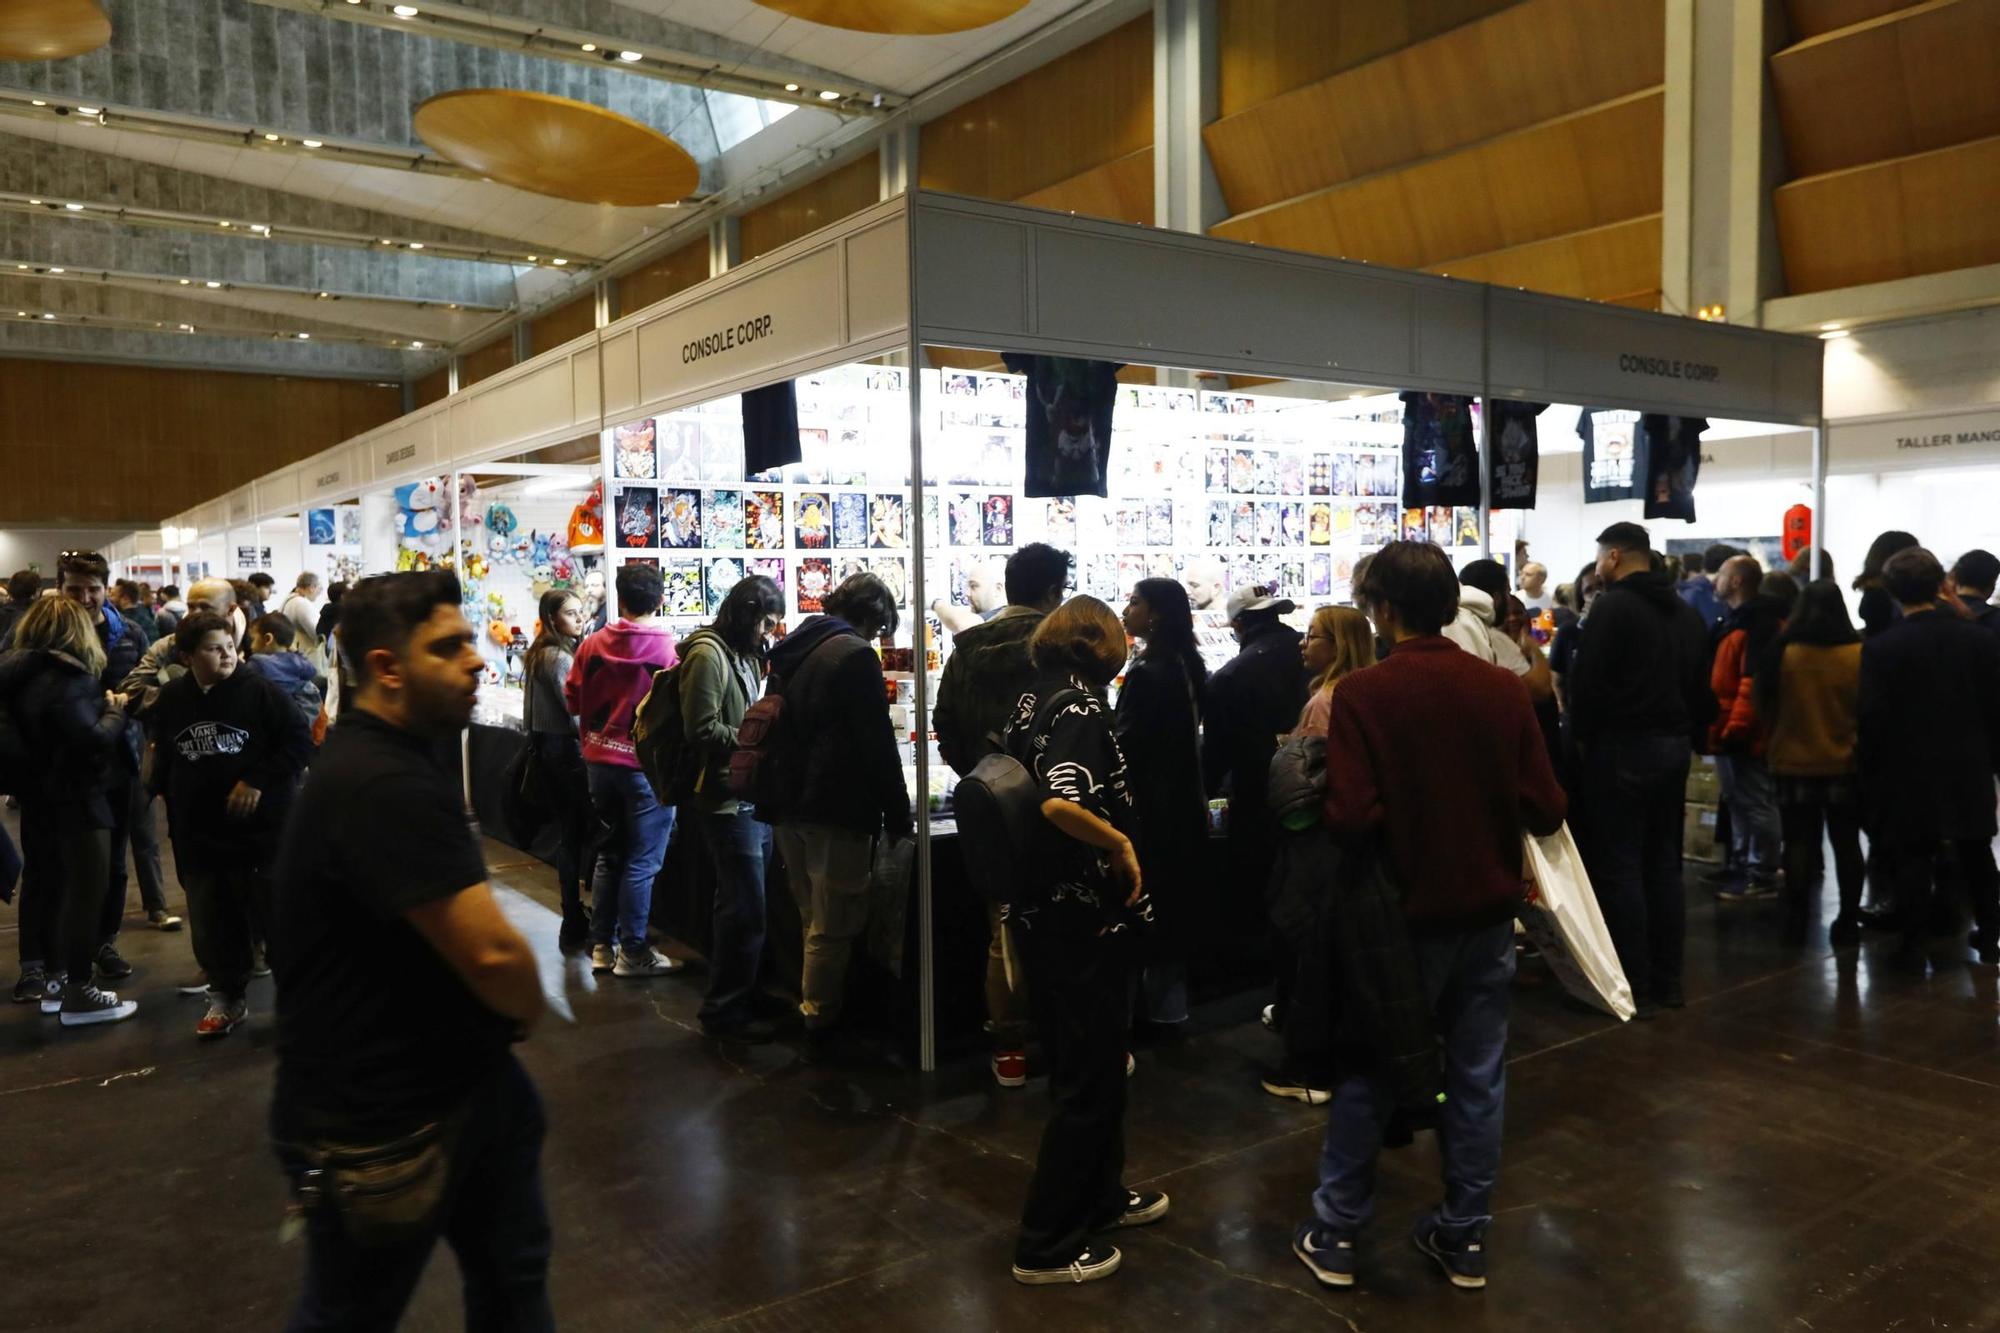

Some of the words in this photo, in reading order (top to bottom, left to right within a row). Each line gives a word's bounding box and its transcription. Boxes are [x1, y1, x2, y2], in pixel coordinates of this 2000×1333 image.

[682, 327, 735, 364] CONSOLE
[737, 314, 774, 345] CORP.
[1620, 353, 1682, 379] CONSOLE
[1896, 434, 1952, 450] TALLER
[189, 724, 217, 738] VANS
